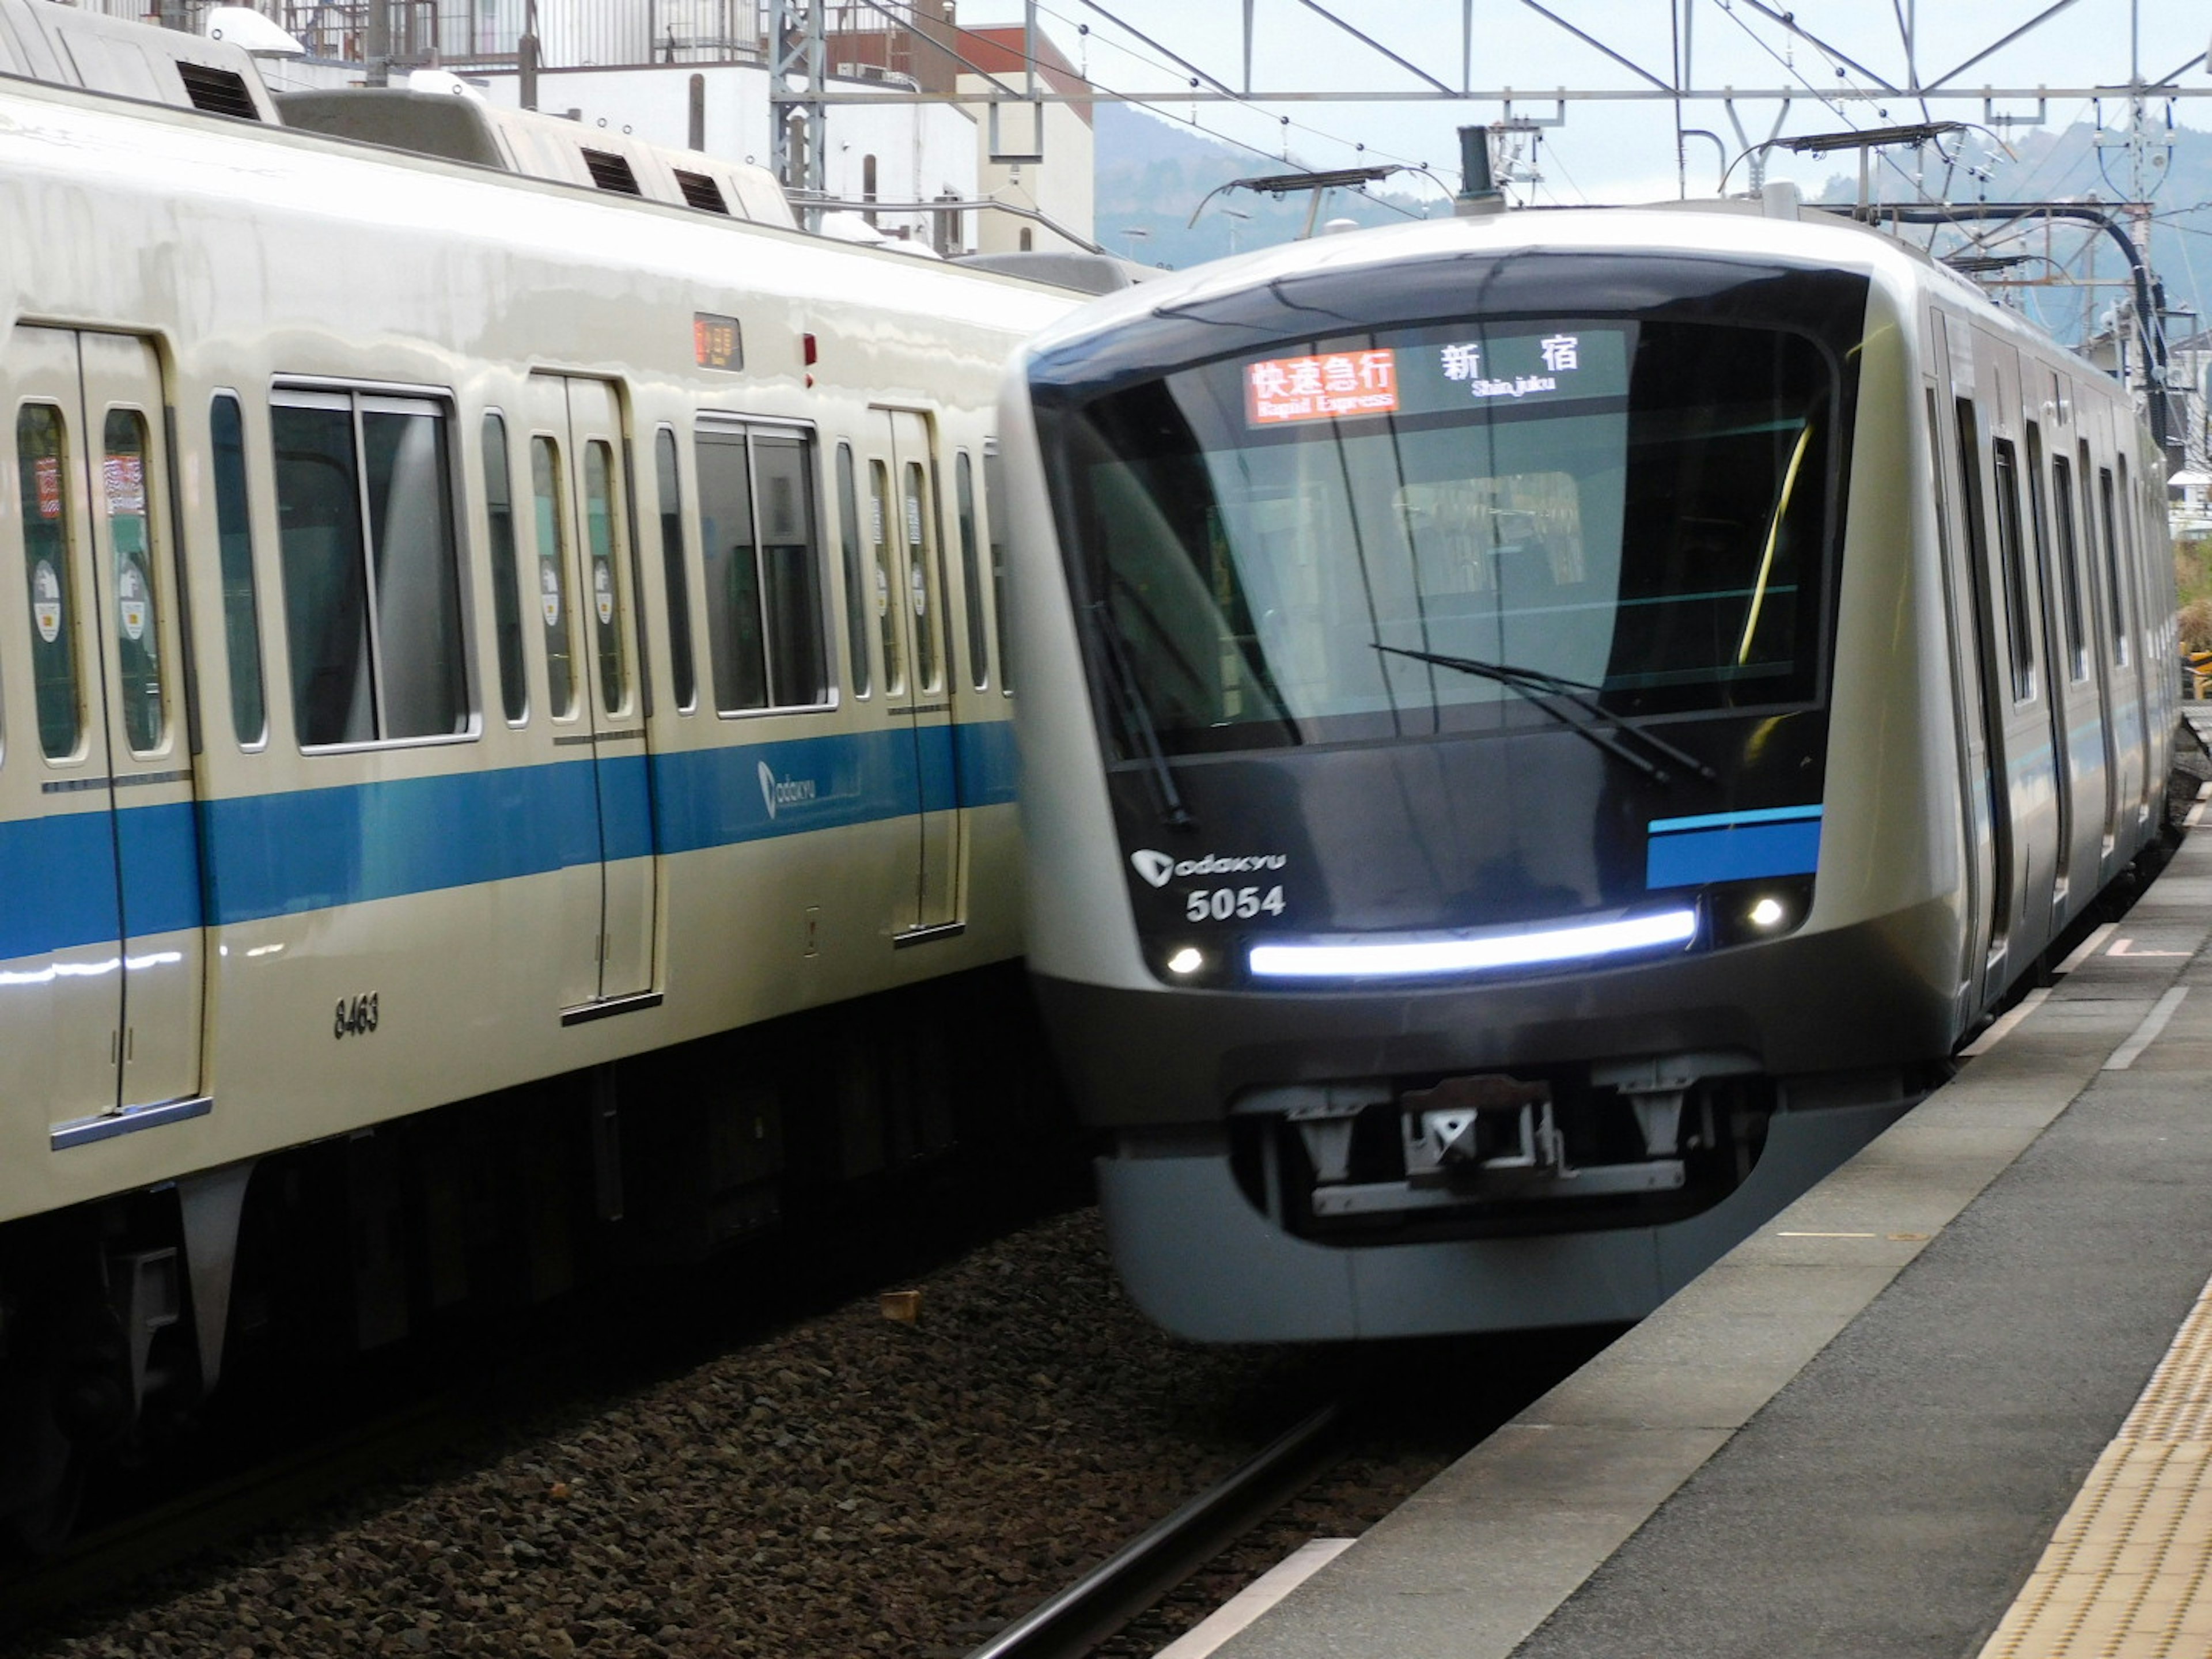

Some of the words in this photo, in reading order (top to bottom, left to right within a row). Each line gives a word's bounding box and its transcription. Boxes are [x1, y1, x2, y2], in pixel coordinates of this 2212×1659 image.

[1252, 353, 1394, 397] 快速急行
[1471, 376, 1556, 397] Shinjuku
[1316, 393, 1395, 414] Express
[1174, 853, 1287, 876] odakyu
[1186, 885, 1286, 923] 5054
[334, 991, 378, 1040] 8463
